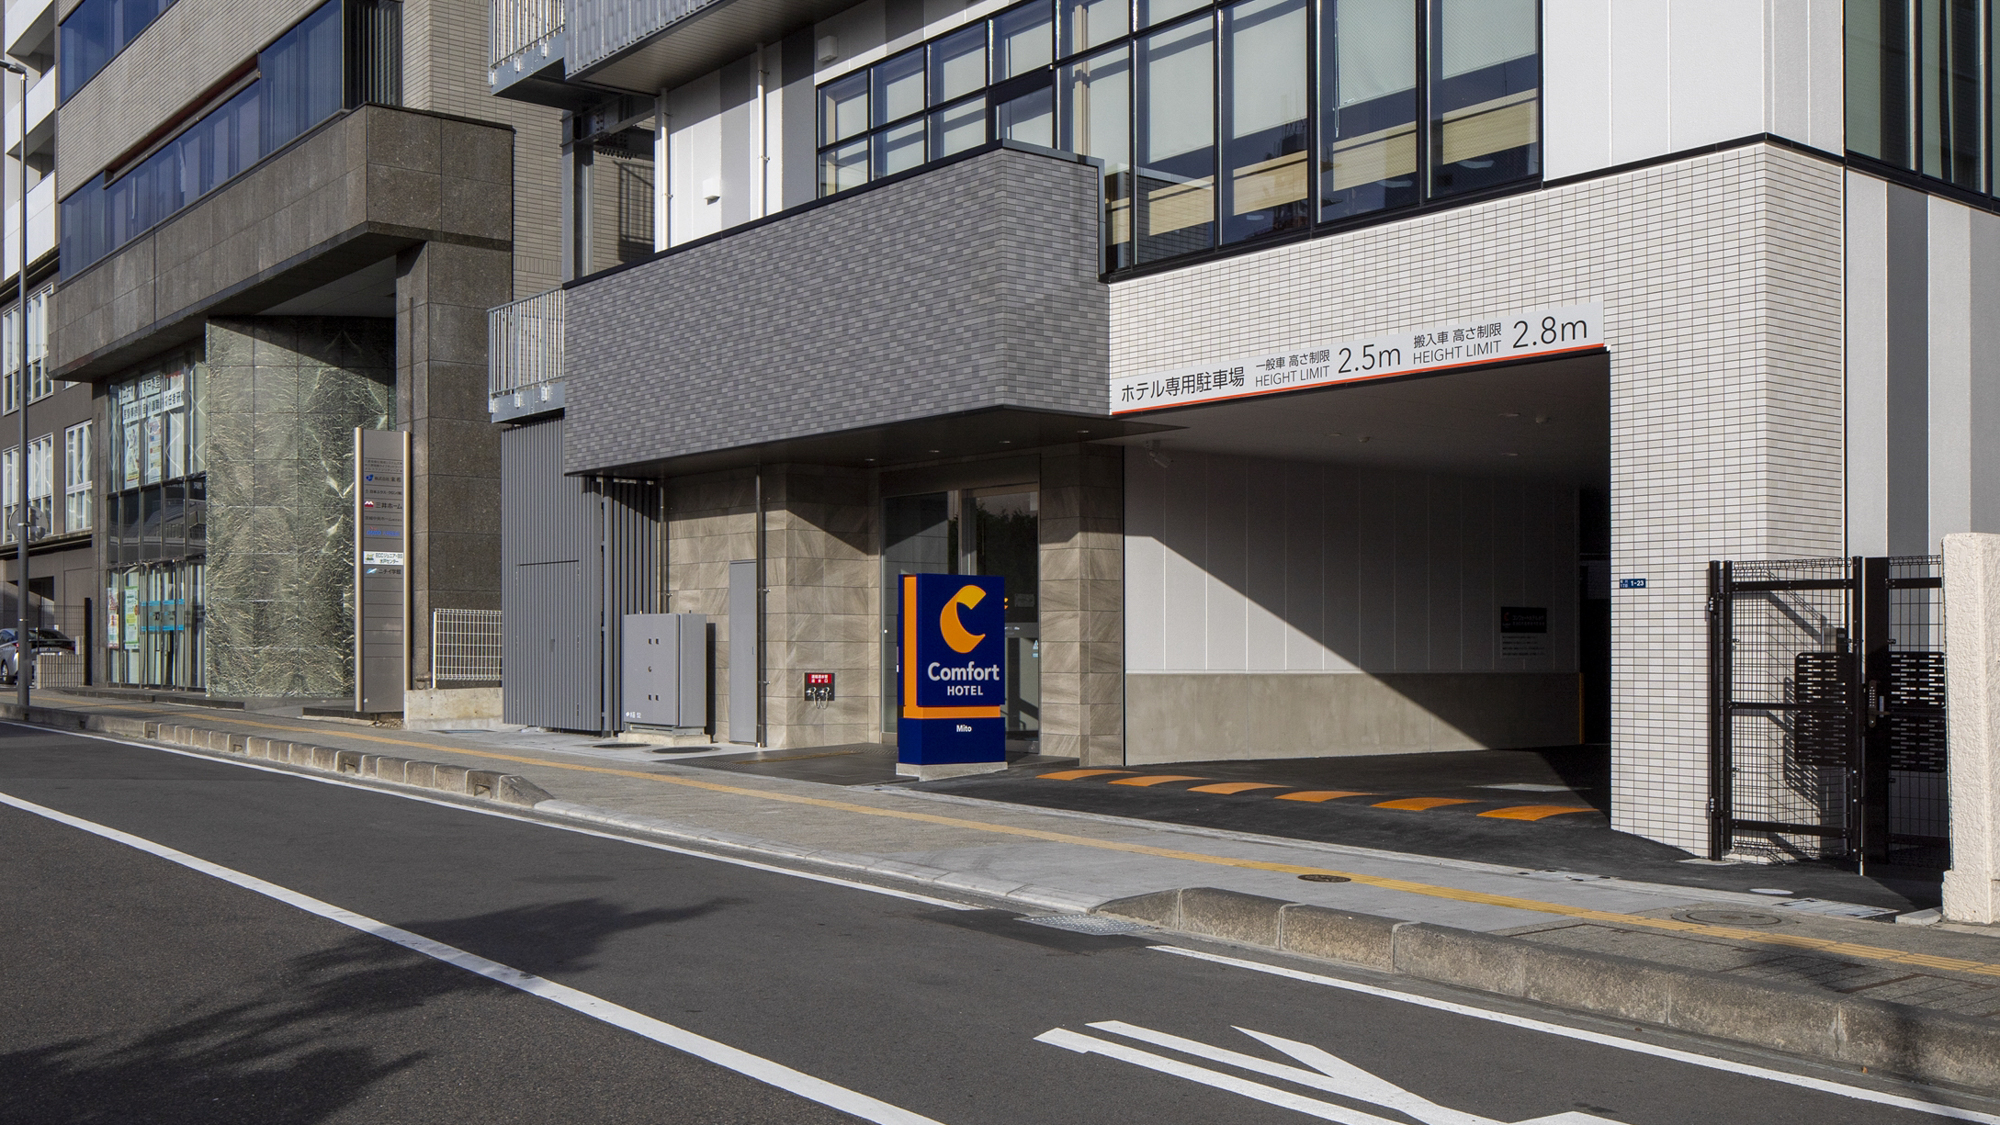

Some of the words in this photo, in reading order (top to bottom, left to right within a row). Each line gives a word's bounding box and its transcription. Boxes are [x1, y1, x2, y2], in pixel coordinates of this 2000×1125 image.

[1413, 331, 1450, 349] 搬入車
[1452, 322, 1502, 343] 高さ制限
[1512, 316, 1588, 349] 2.8m
[1255, 356, 1286, 371] 一般車
[1288, 349, 1330, 367] 高さ制限
[1338, 344, 1401, 374] 2.5m
[1413, 346, 1463, 365] HEIGHT
[1466, 340, 1502, 358] LIMIT
[1121, 366, 1245, 402] ホテル専用駐車場
[1255, 370, 1297, 387] HEIGHT
[1300, 365, 1331, 381] LIMIT
[1630, 579, 1645, 587] 1-23
[927, 661, 1000, 681] Comfort
[947, 685, 984, 696] HOTEL
[956, 724, 973, 733] Mito
